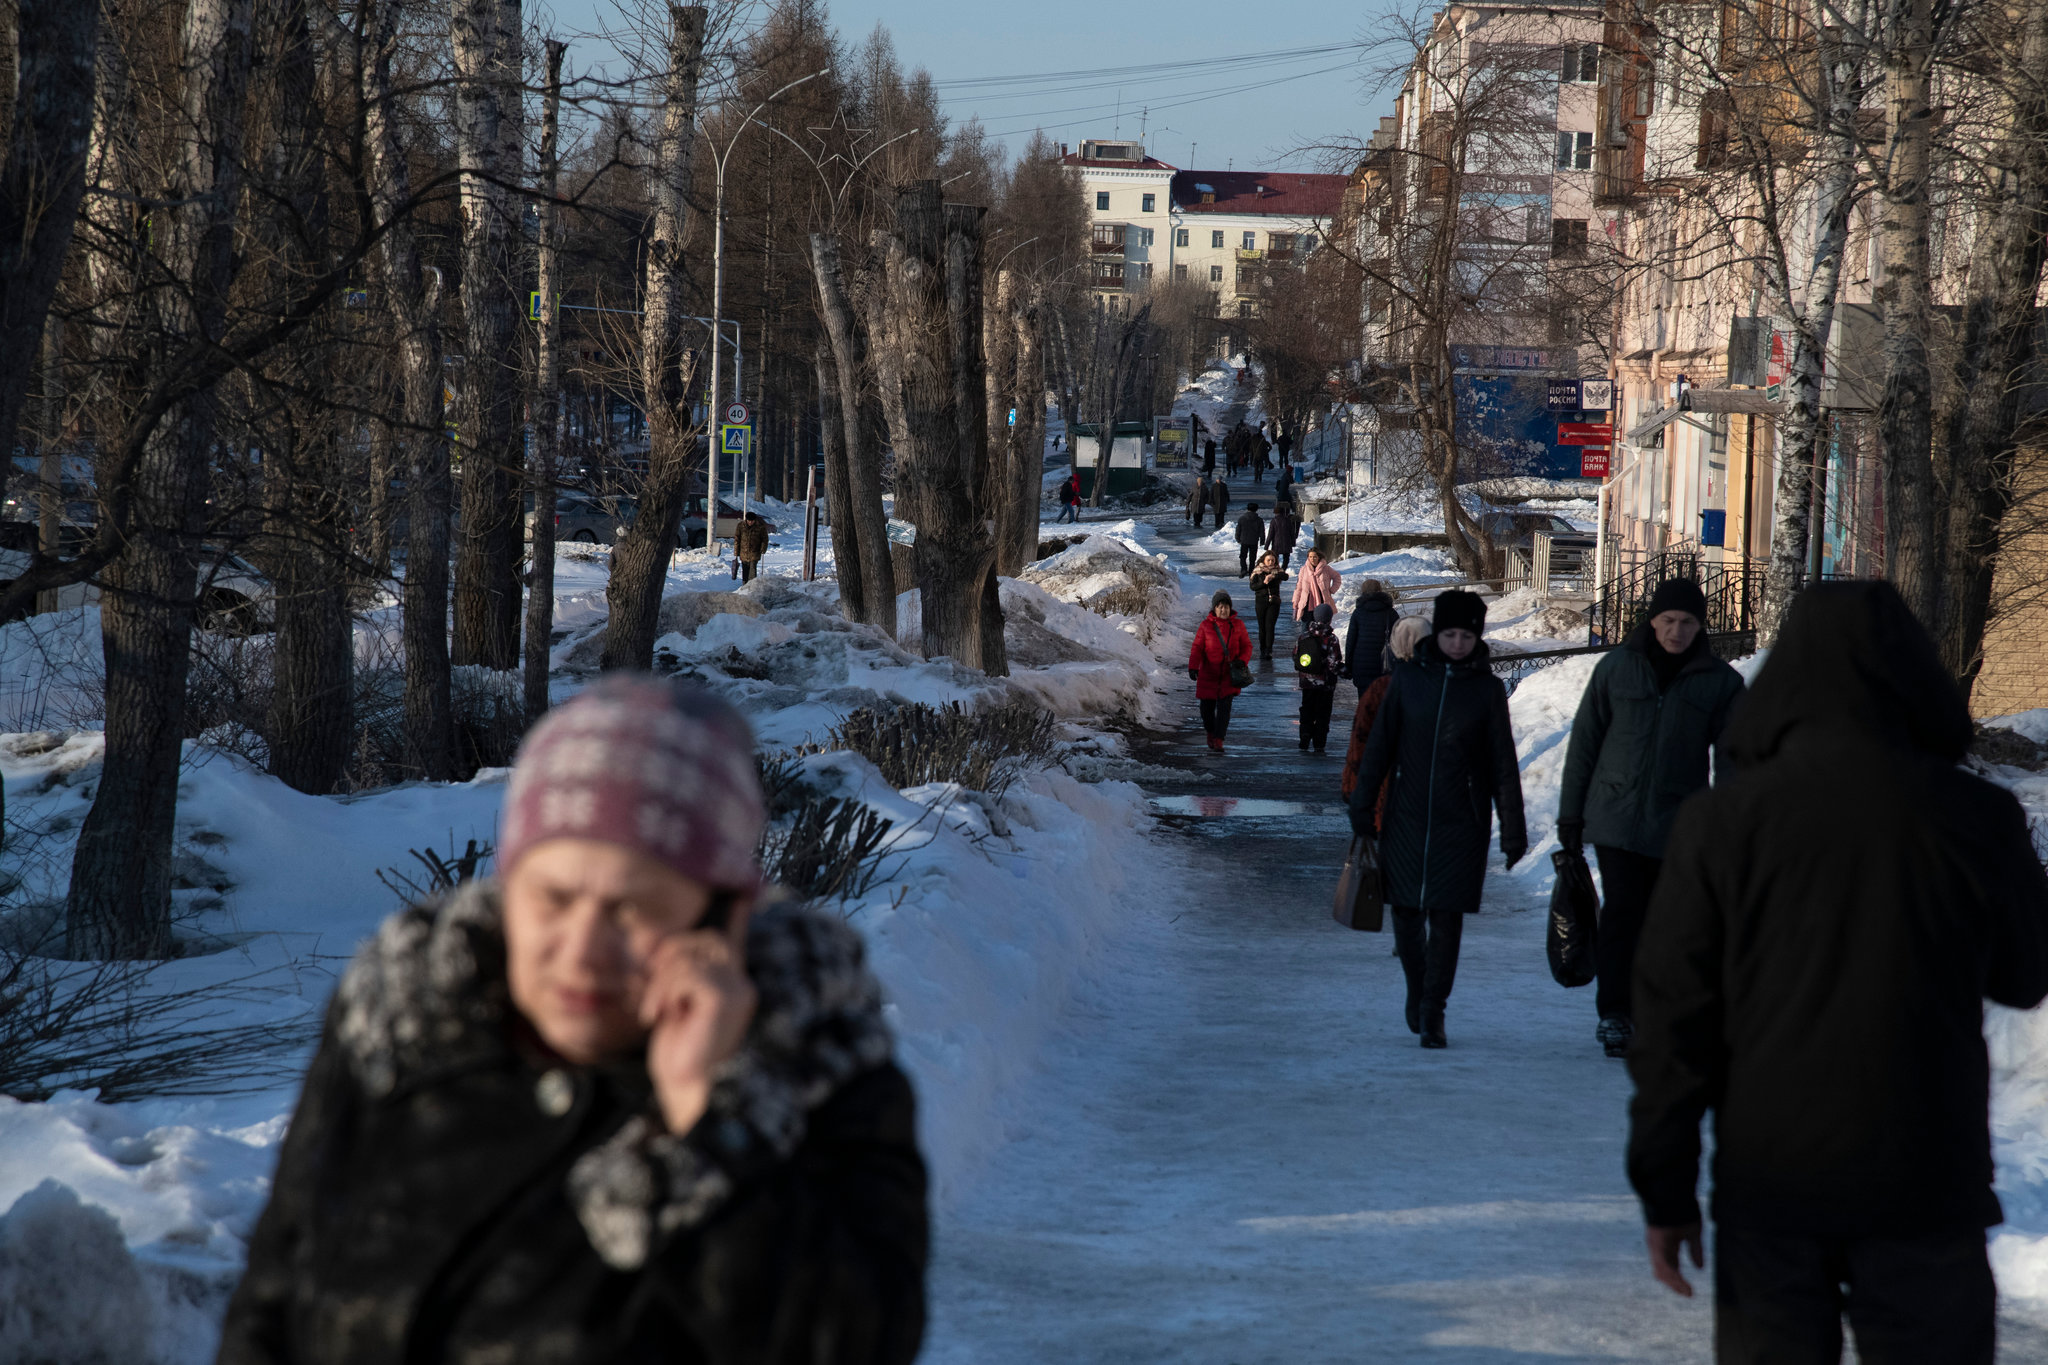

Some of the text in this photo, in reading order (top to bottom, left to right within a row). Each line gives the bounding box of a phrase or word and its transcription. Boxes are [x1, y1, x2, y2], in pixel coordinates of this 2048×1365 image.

[1549, 386, 1576, 394] ПОЧТА
[1549, 396, 1576, 404] РОССИИ
[730, 409, 743, 418] 40
[1584, 455, 1607, 463] ПОЧТА
[1584, 463, 1604, 471] БАНК
